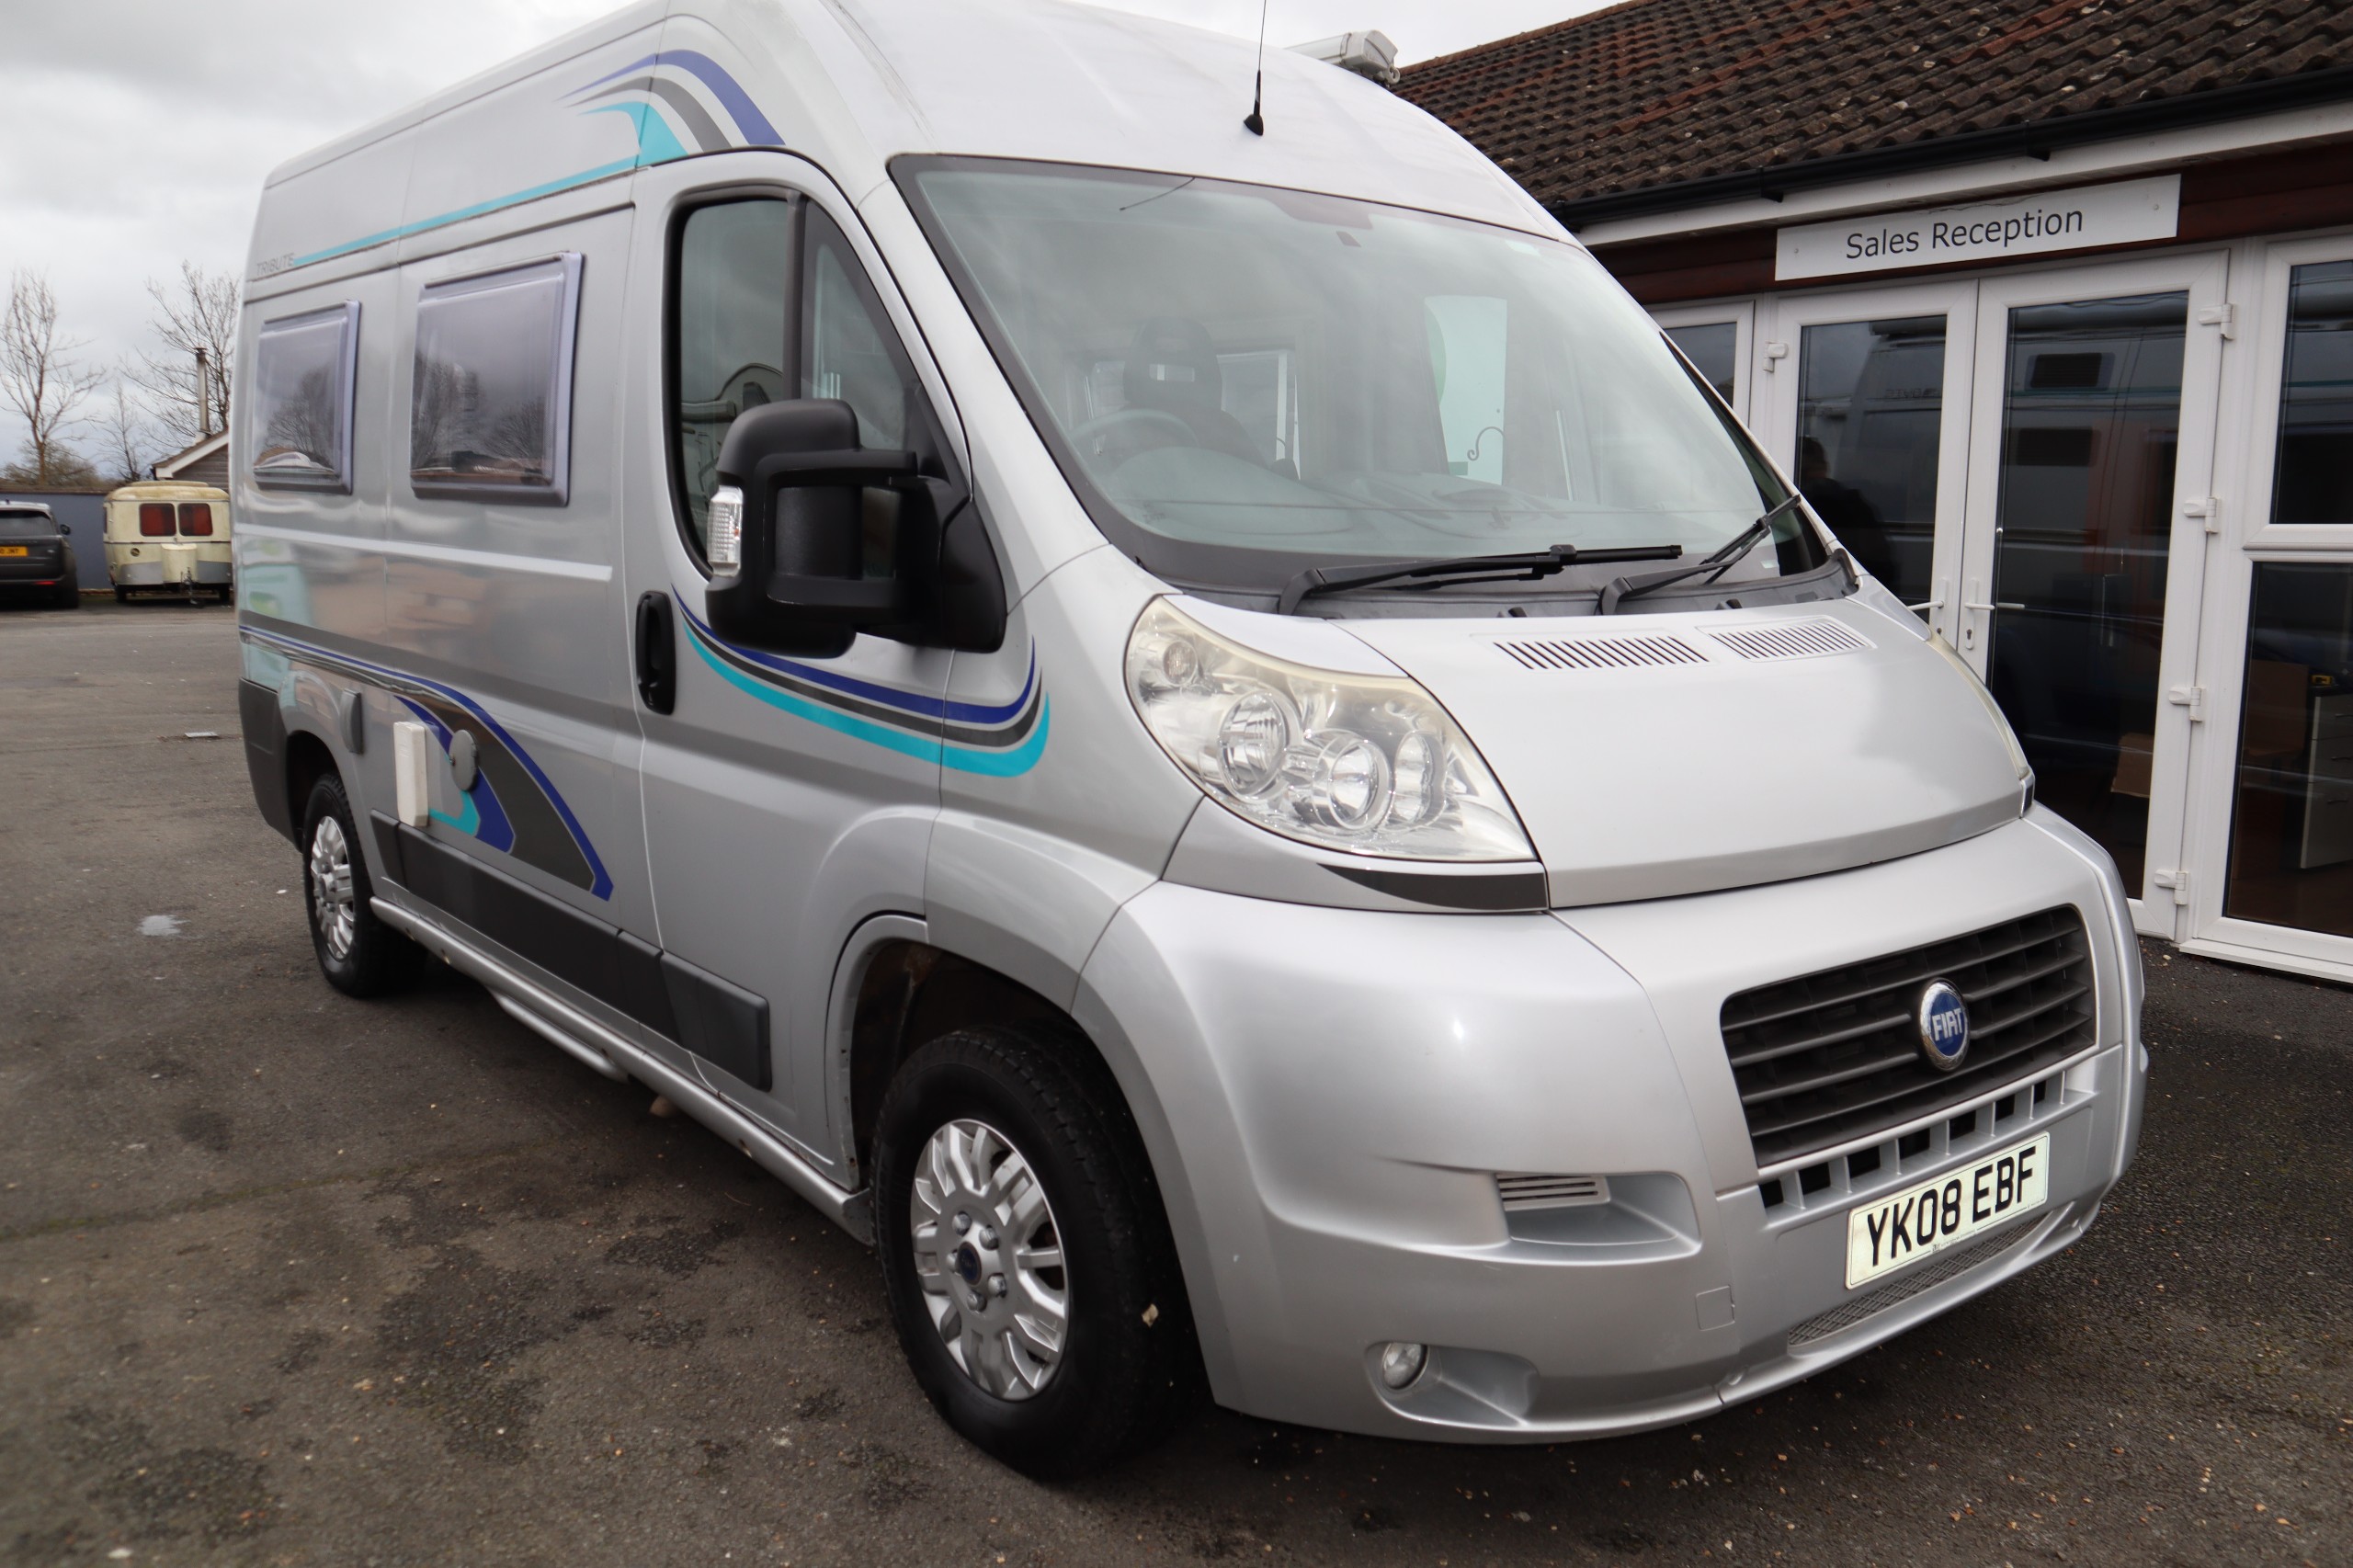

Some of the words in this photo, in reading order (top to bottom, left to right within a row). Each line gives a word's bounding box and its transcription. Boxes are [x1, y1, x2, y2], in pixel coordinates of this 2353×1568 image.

[1846, 228, 1919, 259] Sales
[1931, 209, 2084, 249] Reception
[256, 252, 294, 276] TRIBUTE
[1932, 1007, 1962, 1041] FIAT
[1867, 1178, 1961, 1267] YK08
[1972, 1145, 2037, 1223] EBF
